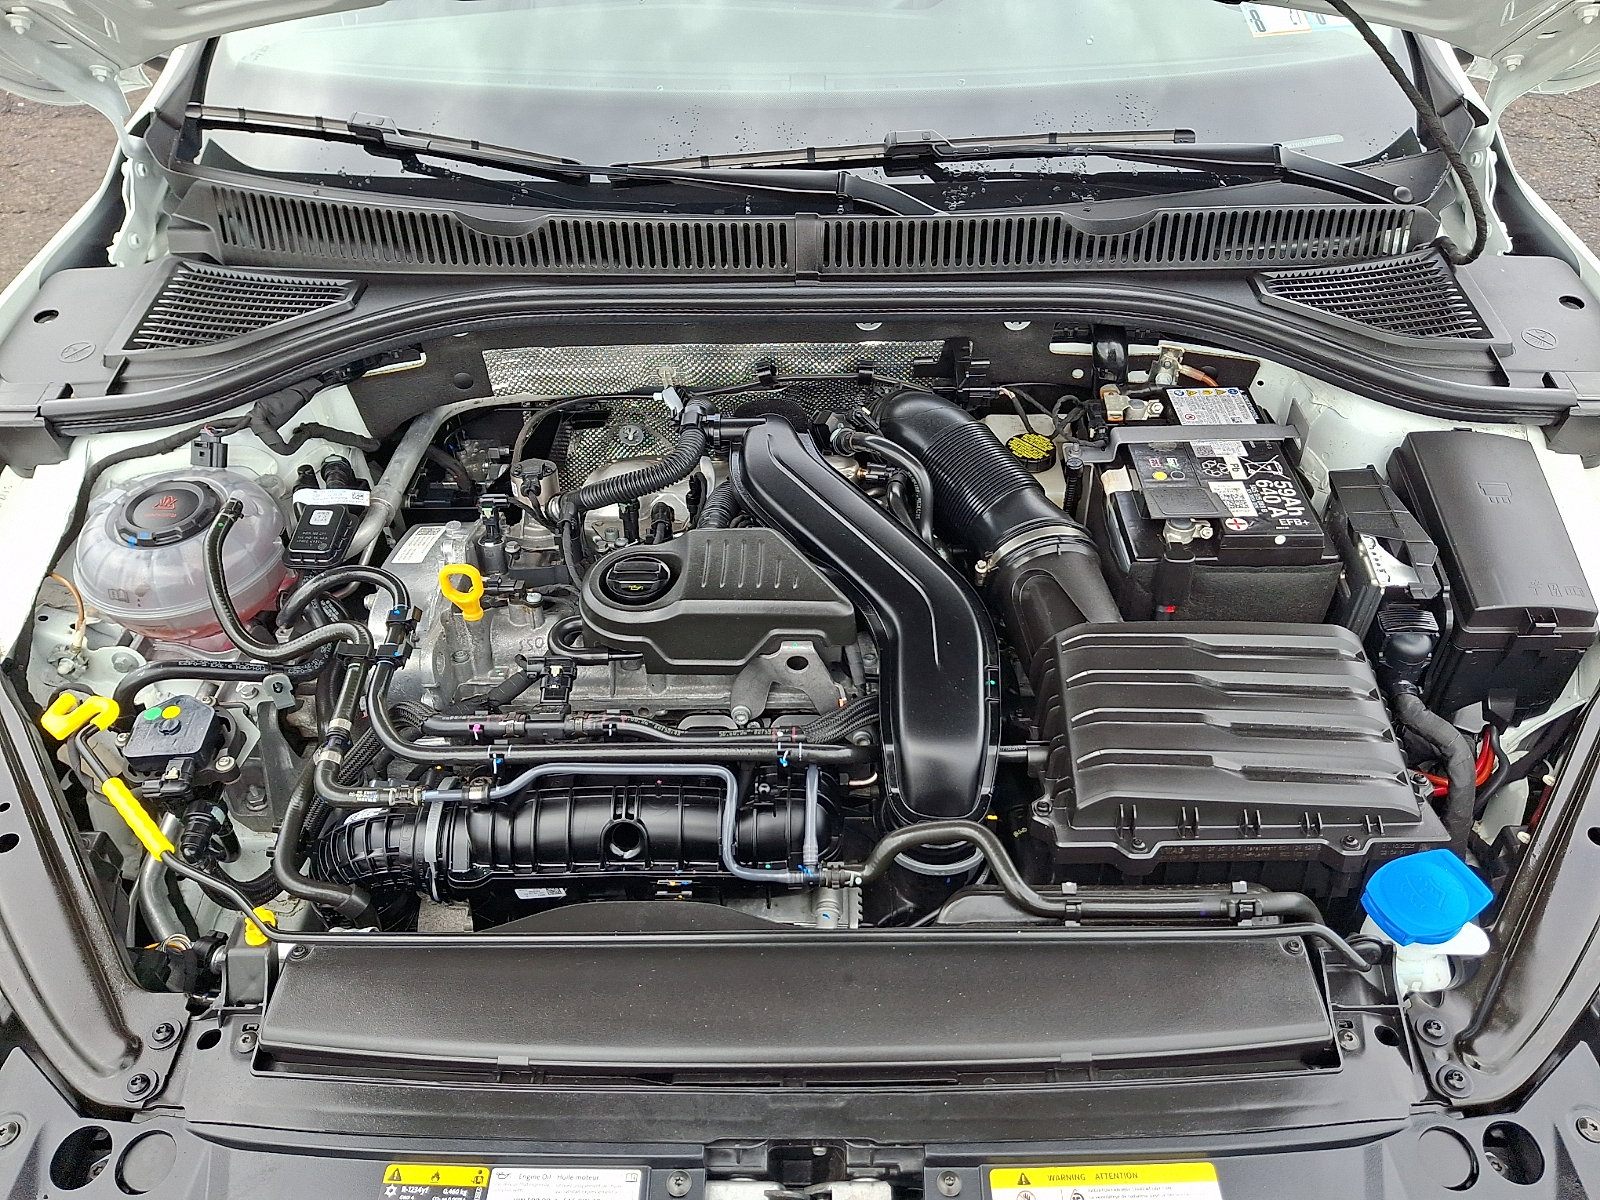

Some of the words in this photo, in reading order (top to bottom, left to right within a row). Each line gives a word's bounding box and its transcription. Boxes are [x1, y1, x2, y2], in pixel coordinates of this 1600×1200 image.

[1230, 463, 1241, 472] Pb
[1255, 479, 1282, 504] 640
[1273, 480, 1306, 517] 59Ah
[1267, 506, 1289, 518] A
[1278, 518, 1311, 527] EFB+
[518, 1172, 541, 1181] Engine
[541, 1172, 552, 1181] Oil
[1047, 1173, 1086, 1182] WARNING
[1095, 1172, 1139, 1180] ATTENTION
